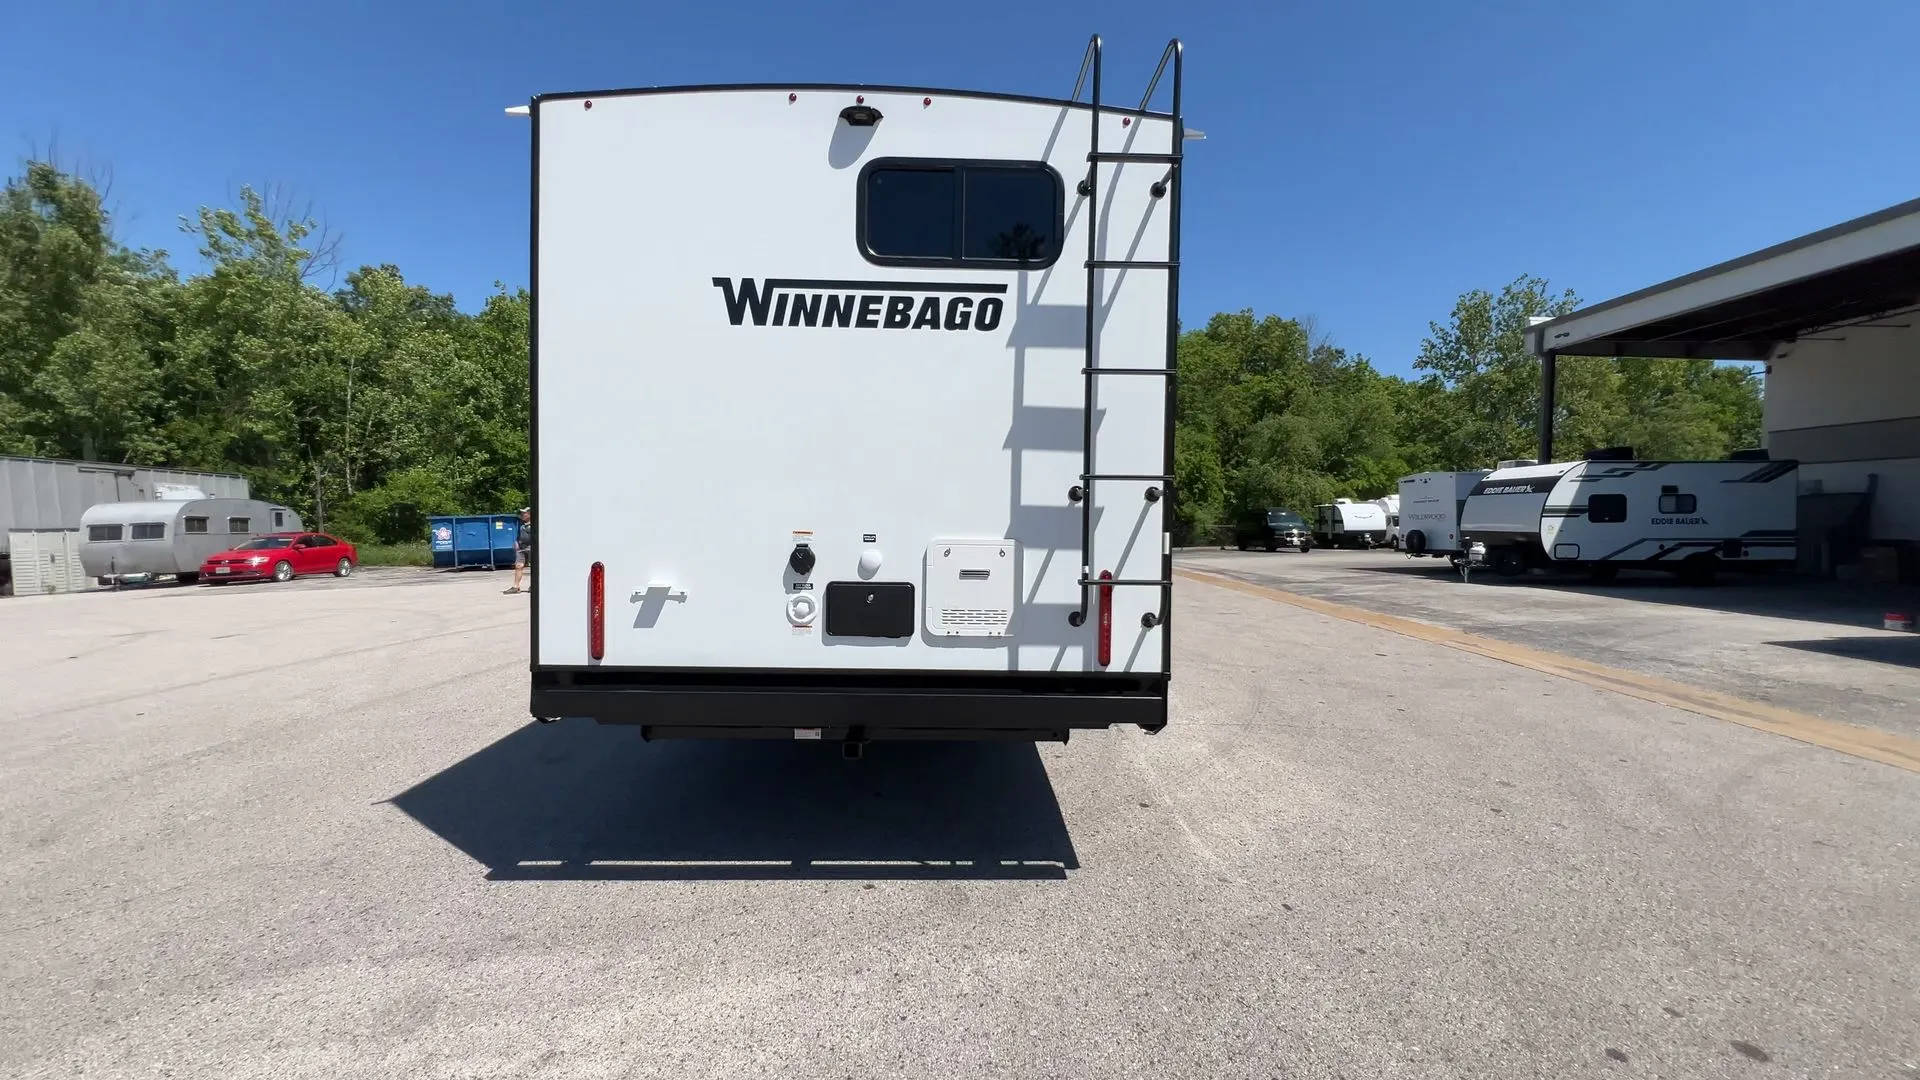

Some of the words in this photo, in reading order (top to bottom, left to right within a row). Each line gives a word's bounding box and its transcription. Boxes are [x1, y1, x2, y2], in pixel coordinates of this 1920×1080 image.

[712, 277, 1009, 331] WINNEBAGO
[1650, 517, 1674, 525] EDDIE
[1675, 517, 1700, 525] BAUER
